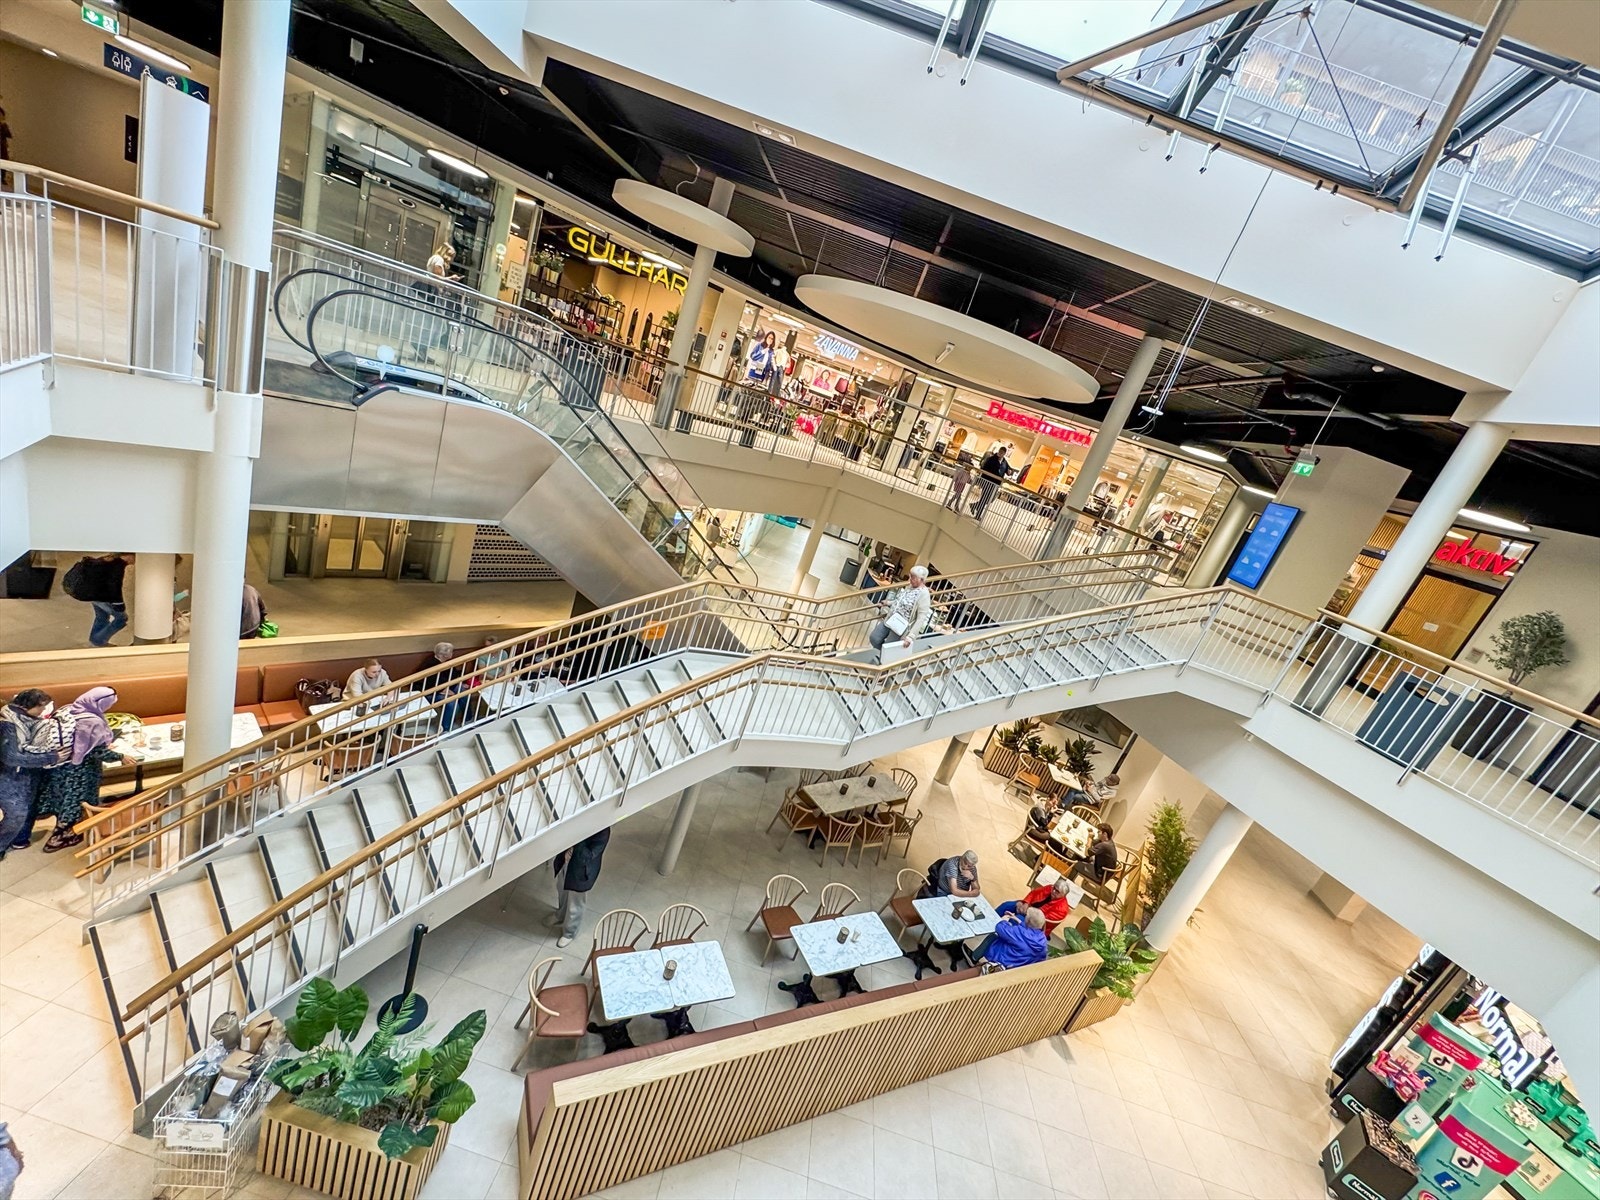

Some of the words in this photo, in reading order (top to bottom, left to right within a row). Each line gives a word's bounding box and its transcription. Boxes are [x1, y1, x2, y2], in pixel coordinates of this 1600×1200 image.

[813, 334, 860, 361] ZAVANNA
[986, 401, 1092, 447] Dressmann
[1435, 538, 1519, 575] aktiv
[1474, 986, 1542, 1091] Normal
